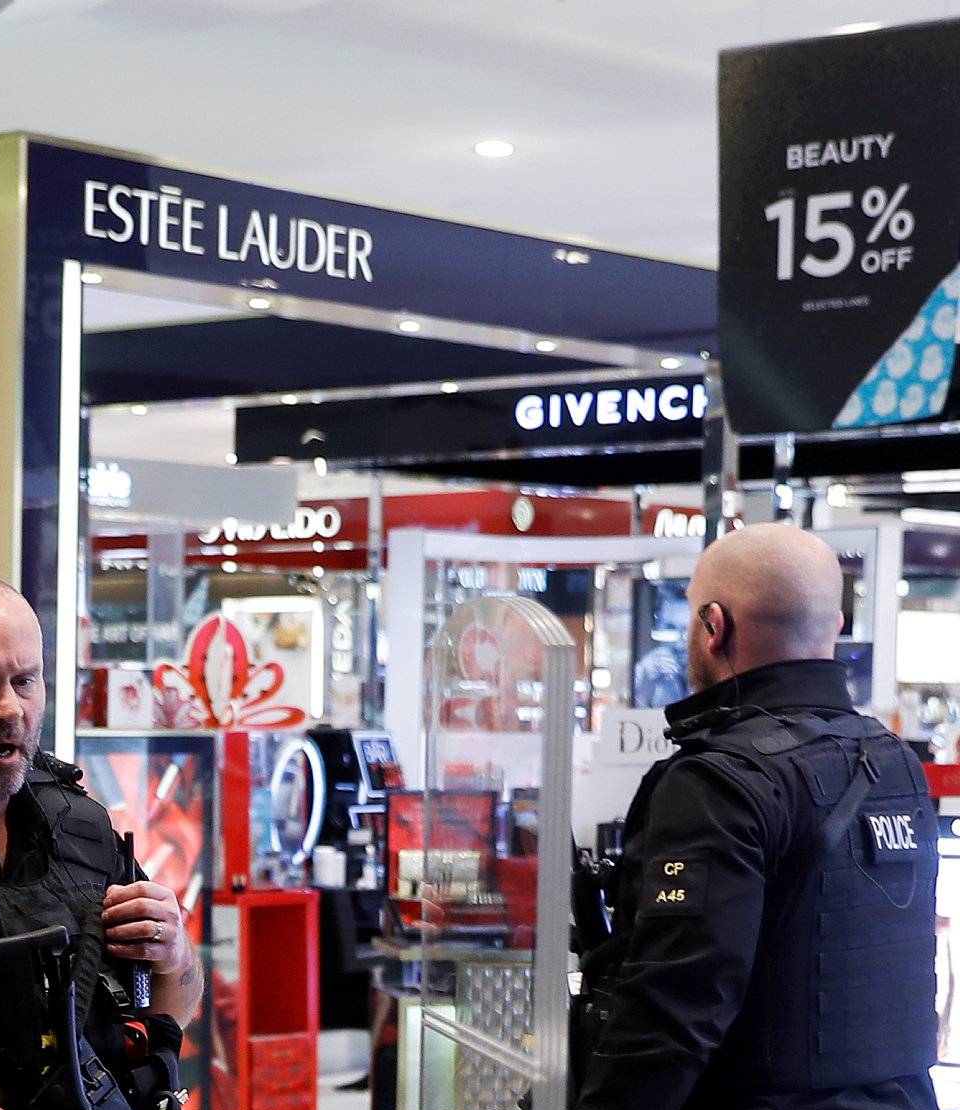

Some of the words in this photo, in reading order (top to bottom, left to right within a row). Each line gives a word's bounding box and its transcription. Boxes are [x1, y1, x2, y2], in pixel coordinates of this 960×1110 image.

[786, 132, 895, 170] BEAUTY
[218, 204, 373, 283] LAUDER
[860, 246, 915, 274] OFF
[870, 814, 918, 850] POLICE
[663, 861, 685, 876] CP
[655, 888, 685, 903] A45
